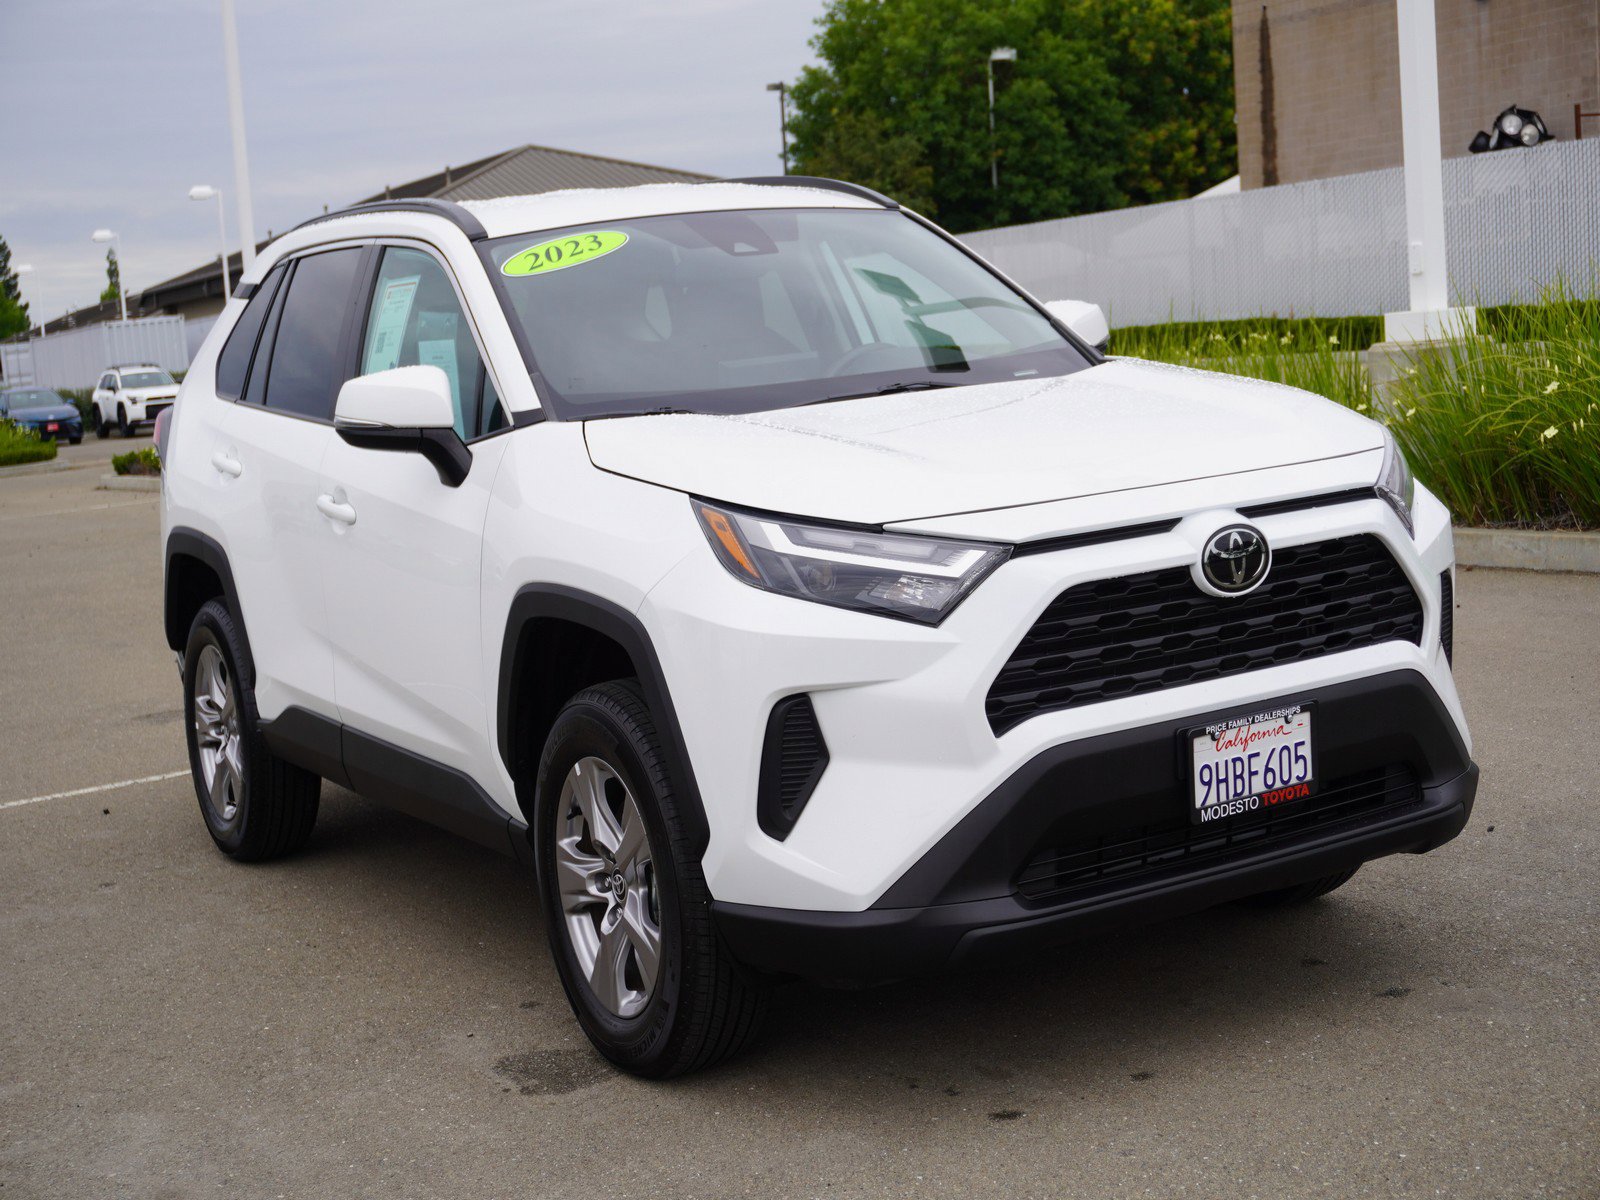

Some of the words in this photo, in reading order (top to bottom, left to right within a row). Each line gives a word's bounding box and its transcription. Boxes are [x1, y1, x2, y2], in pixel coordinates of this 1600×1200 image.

[523, 234, 603, 272] 2023
[1206, 723, 1227, 735] PRICE
[1228, 716, 1254, 729] FAMILY
[1254, 706, 1301, 723] DEALERSHIPS
[1215, 725, 1292, 752] California
[1199, 740, 1308, 807] 9HBF605
[1201, 796, 1259, 822] MODESTO
[1262, 784, 1310, 806] TOYOTA
